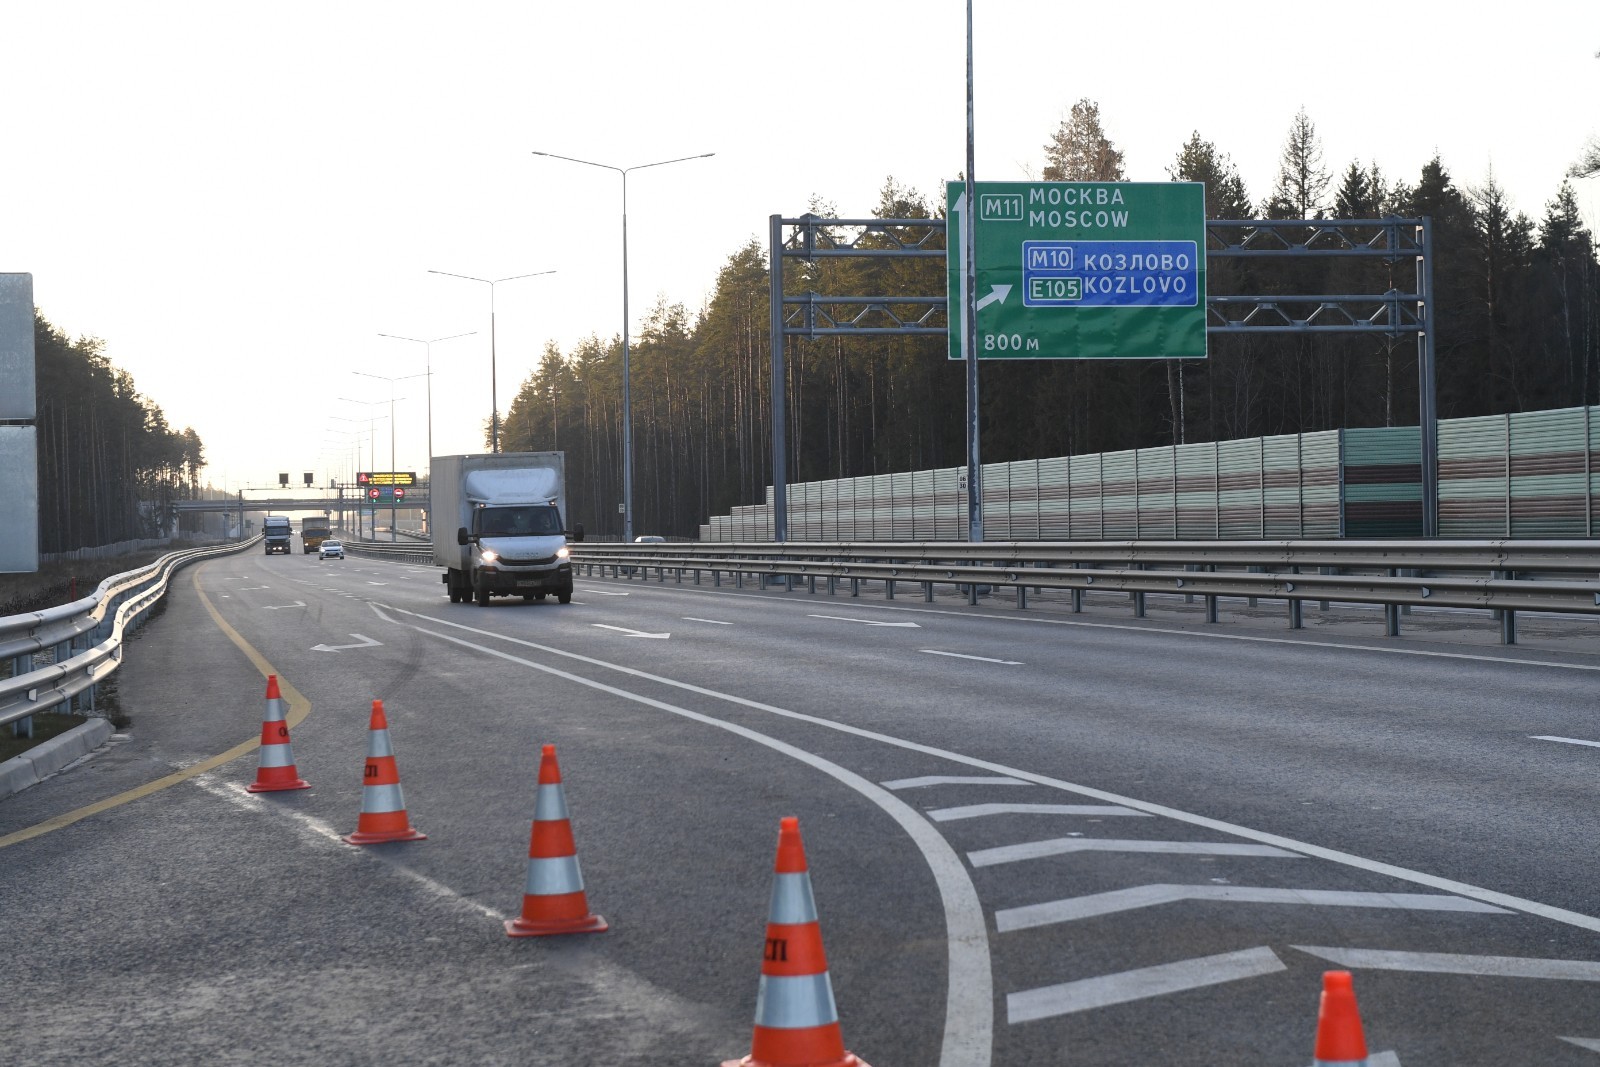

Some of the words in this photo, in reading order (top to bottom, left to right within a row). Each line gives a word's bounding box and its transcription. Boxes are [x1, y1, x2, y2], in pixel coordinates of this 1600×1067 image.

[1030, 189, 1124, 205] МОСКВА
[986, 199, 1019, 216] M11
[1030, 211, 1129, 227] MOSCOW
[1032, 251, 1070, 267] M10
[1085, 254, 1189, 270] КОЗЛОВО
[1033, 281, 1078, 297] E105
[1085, 277, 1186, 293] KOZLOVO
[984, 334, 1022, 350] 800
